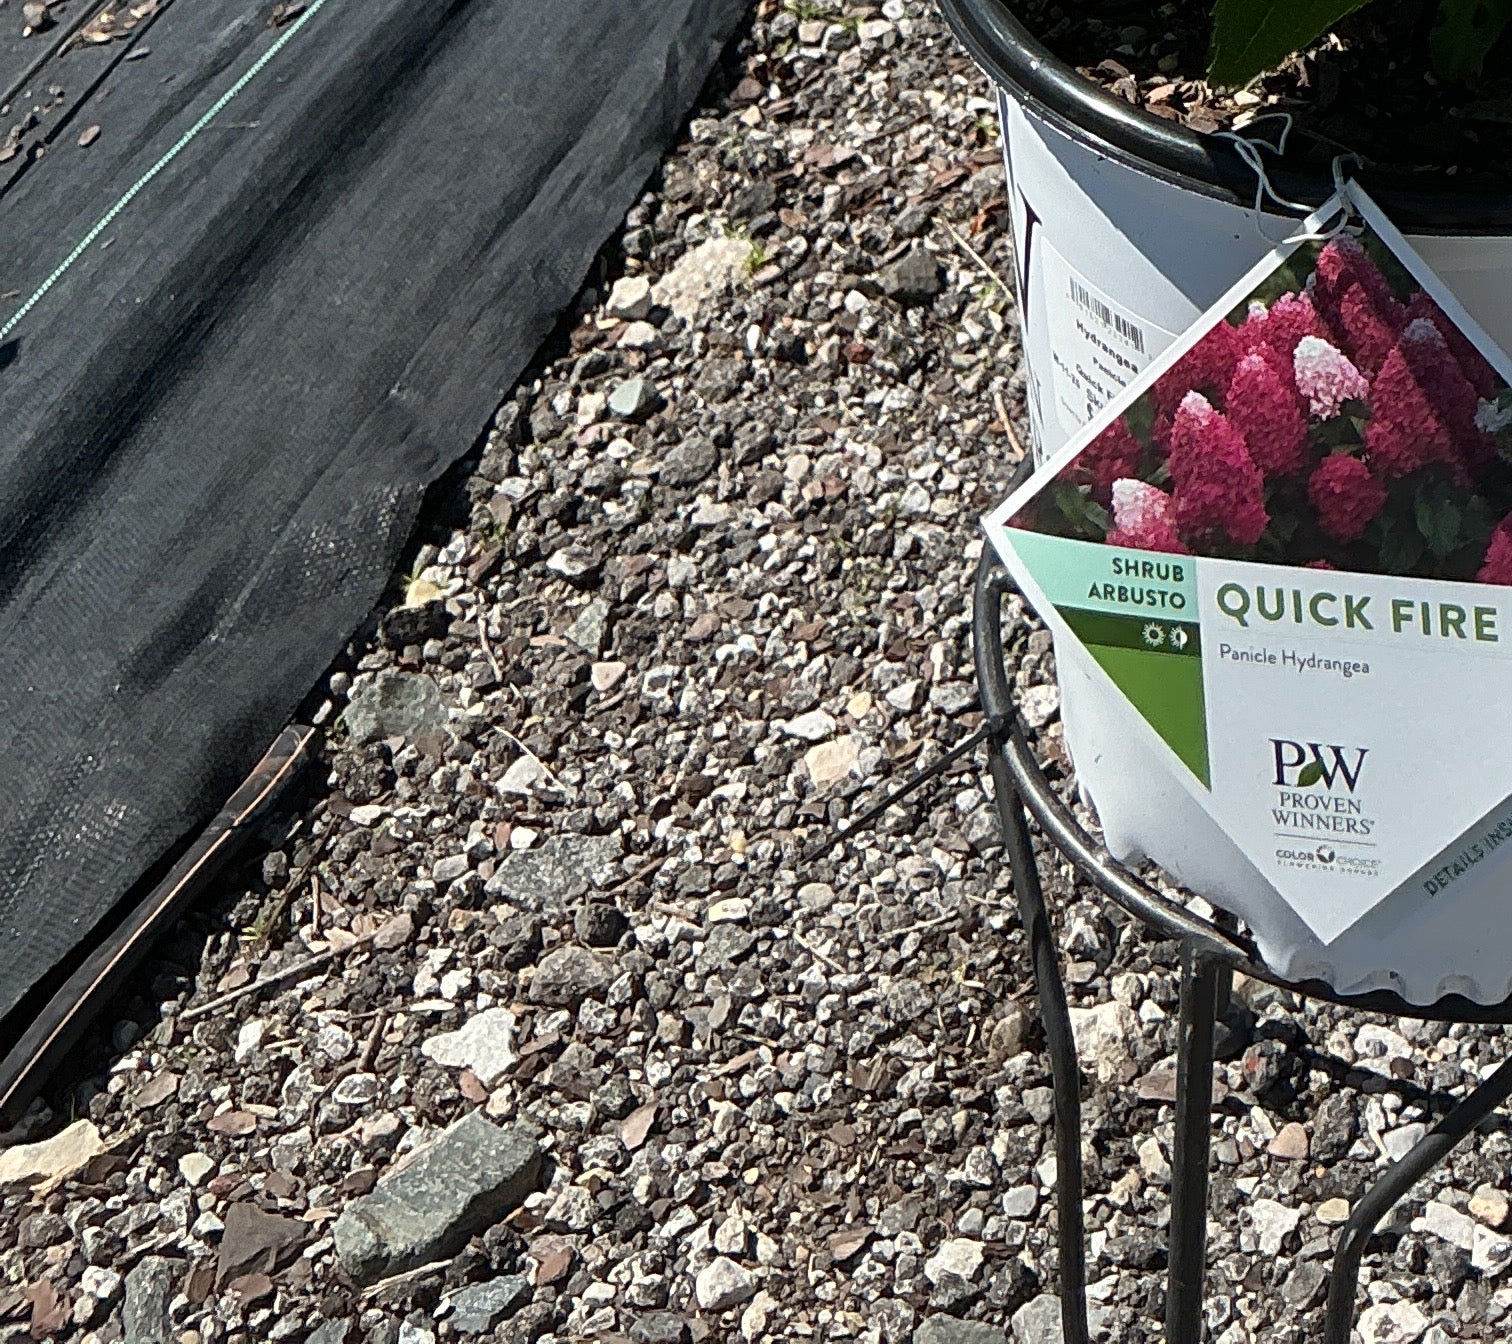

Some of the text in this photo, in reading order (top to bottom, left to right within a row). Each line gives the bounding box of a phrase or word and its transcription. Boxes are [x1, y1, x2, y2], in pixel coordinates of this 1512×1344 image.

[1076, 318, 1138, 374] Hydrangea
[1112, 556, 1185, 582] SHRUB
[1088, 581, 1186, 609] ARBUSTO
[1216, 582, 1374, 630] QUICK
[1391, 598, 1499, 643] FIRE
[1219, 643, 1371, 678] Panicle Hydrangea
[1267, 737, 1371, 795] PW
[1279, 791, 1362, 815] PROVEN
[1275, 848, 1315, 863] COLOR
[1423, 844, 1486, 898] DETAILS
